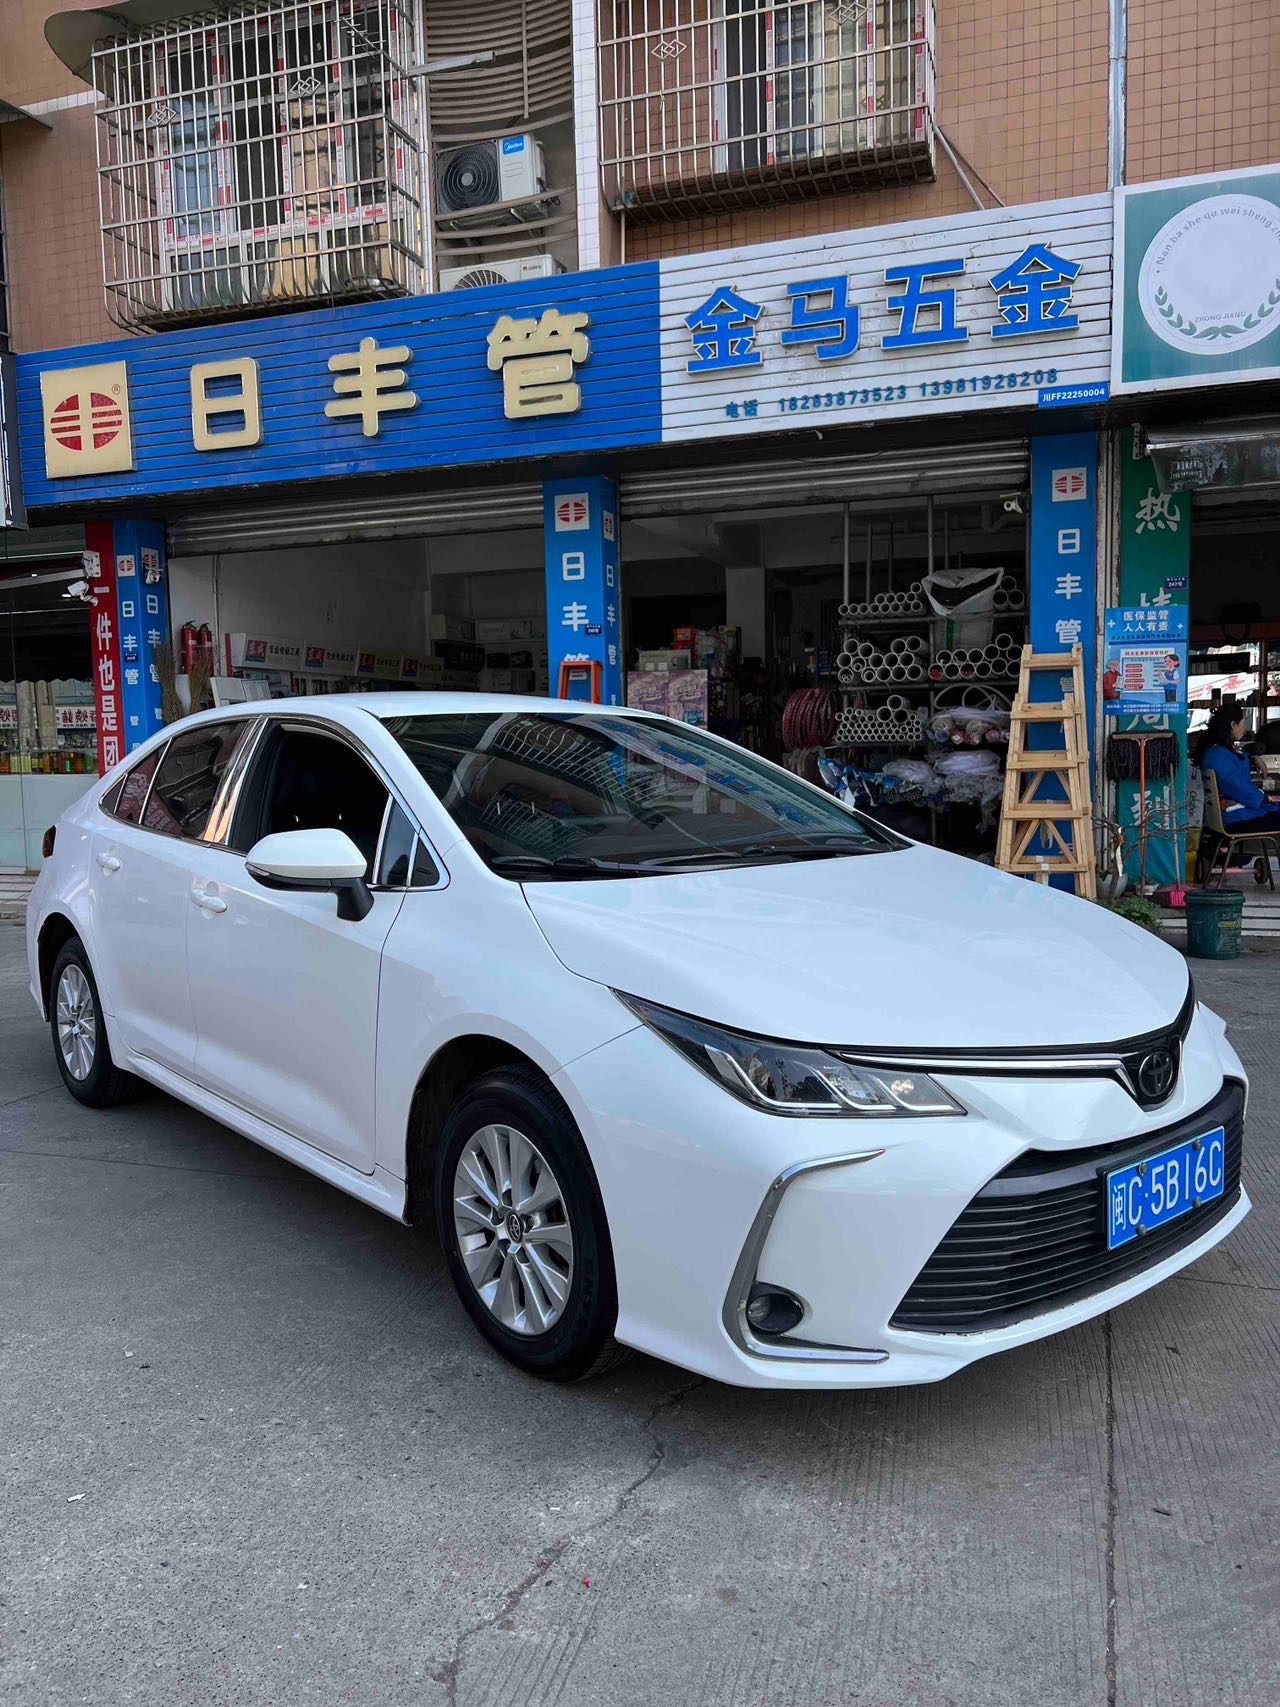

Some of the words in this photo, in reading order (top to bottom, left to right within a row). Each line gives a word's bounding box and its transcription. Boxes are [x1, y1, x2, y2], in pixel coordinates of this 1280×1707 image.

[1156, 244, 1172, 265] Nan
[1171, 231, 1183, 243] ba
[1184, 217, 1201, 231] she
[1204, 210, 1217, 221] qu
[1220, 206, 1241, 216] wei
[1243, 207, 1273, 228] sheng
[684, 243, 1083, 374] 金马五金
[1194, 314, 1222, 323] ZHONG
[1223, 311, 1246, 320] JIANG
[190, 309, 592, 451] 日丰管
[725, 399, 759, 418] 电话
[778, 385, 907, 412] 18283873523
[920, 368, 1058, 397] 13981928208
[1042, 388, 1105, 402] 川FF22250004
[1055, 528, 1083, 644] 日丰管
[122, 600, 140, 685] 日丰管
[1123, 610, 1169, 621] 医保监管
[1123, 621, 1169, 632] 人人有责
